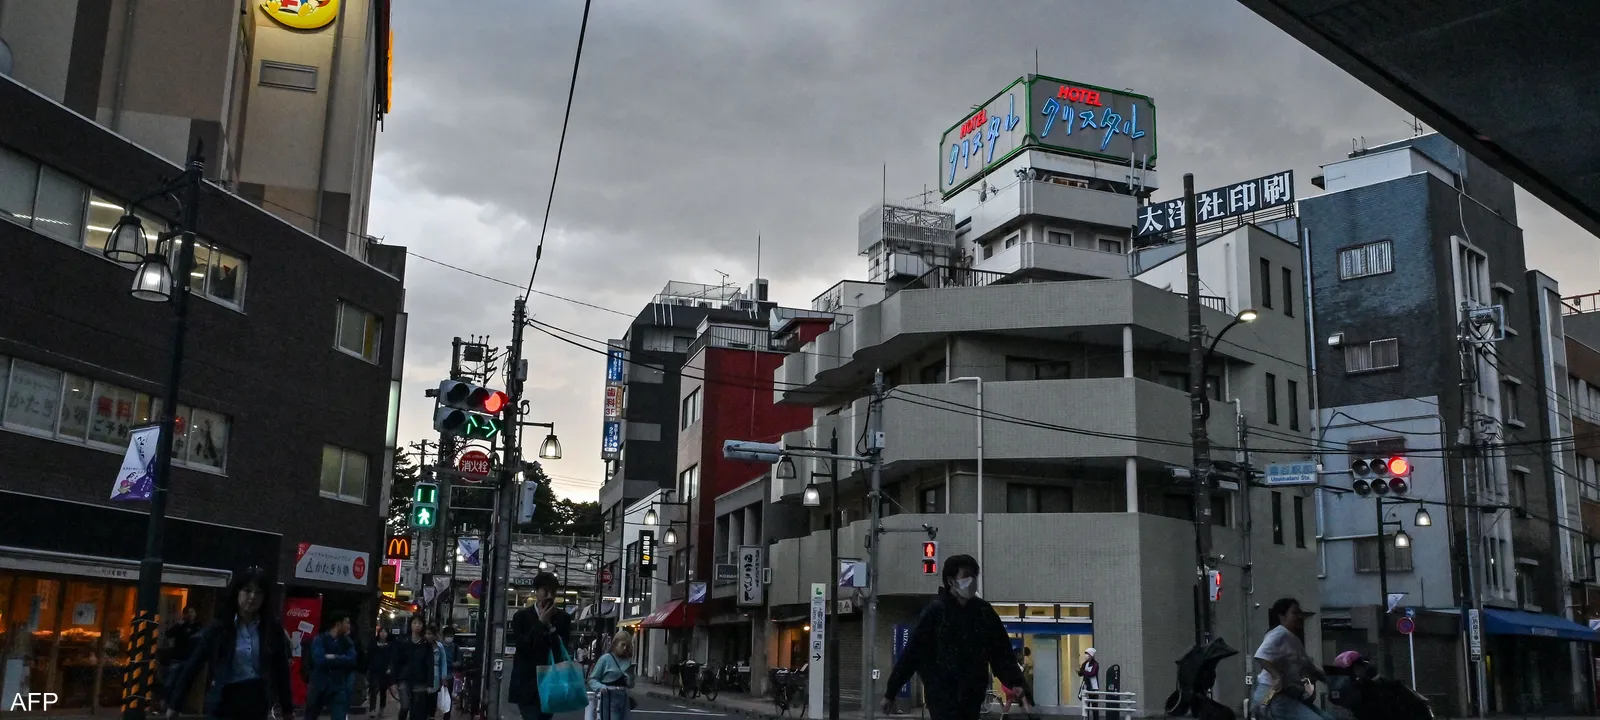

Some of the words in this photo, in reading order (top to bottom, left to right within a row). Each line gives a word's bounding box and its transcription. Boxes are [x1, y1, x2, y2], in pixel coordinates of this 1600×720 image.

[1057, 85, 1102, 107] HOTEL
[959, 109, 988, 139] HOTEL
[1041, 96, 1145, 151] クリスタル
[949, 93, 1020, 185] クリスタル
[1138, 172, 1291, 236] 太洋社印刷
[98, 396, 131, 420] 無料
[462, 460, 488, 472] 消火栓
[315, 561, 349, 577] かたぎり塾
